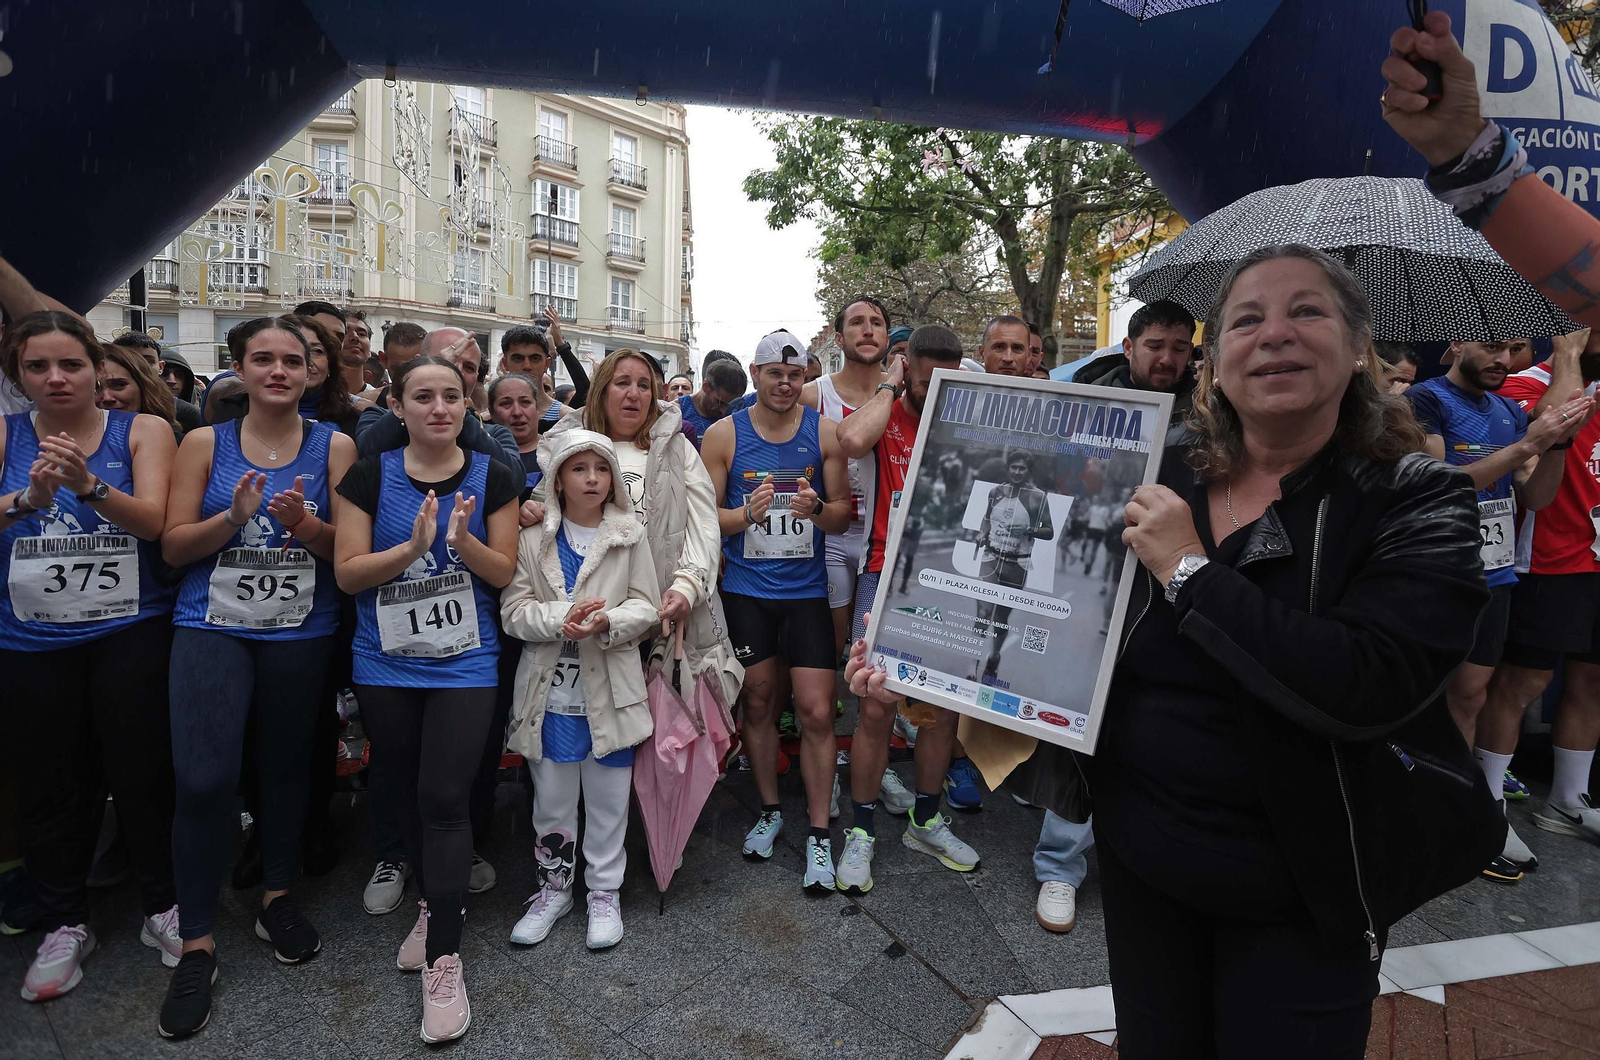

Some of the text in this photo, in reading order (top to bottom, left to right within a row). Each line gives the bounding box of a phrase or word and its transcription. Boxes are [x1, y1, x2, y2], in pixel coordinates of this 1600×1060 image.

[1508, 126, 1589, 149] GACIÓN
[940, 387, 1143, 441] XII INMACULADA
[1070, 432, 1112, 448] ALCALDESA
[765, 514, 804, 536] 116
[1479, 522, 1504, 546] 23
[42, 536, 129, 553] INMACULADA
[43, 561, 121, 593] 375
[236, 574, 299, 602] 595
[398, 573, 465, 599] INMACULADA
[919, 573, 1070, 614] 30/11 PLAZA IGLESIA DESDE 10:00AM
[405, 599, 463, 636] 140
[945, 620, 998, 638] WEB.FAALIVE.COM
[947, 610, 991, 625] INSCRIPCIONES
[990, 621, 1020, 632] ABIERTAS
[884, 624, 911, 637] pruebas
[911, 632, 945, 647] adaptadas
[951, 643, 982, 656] menores
[911, 621, 921, 630] DE
[949, 633, 978, 645] MASTER
